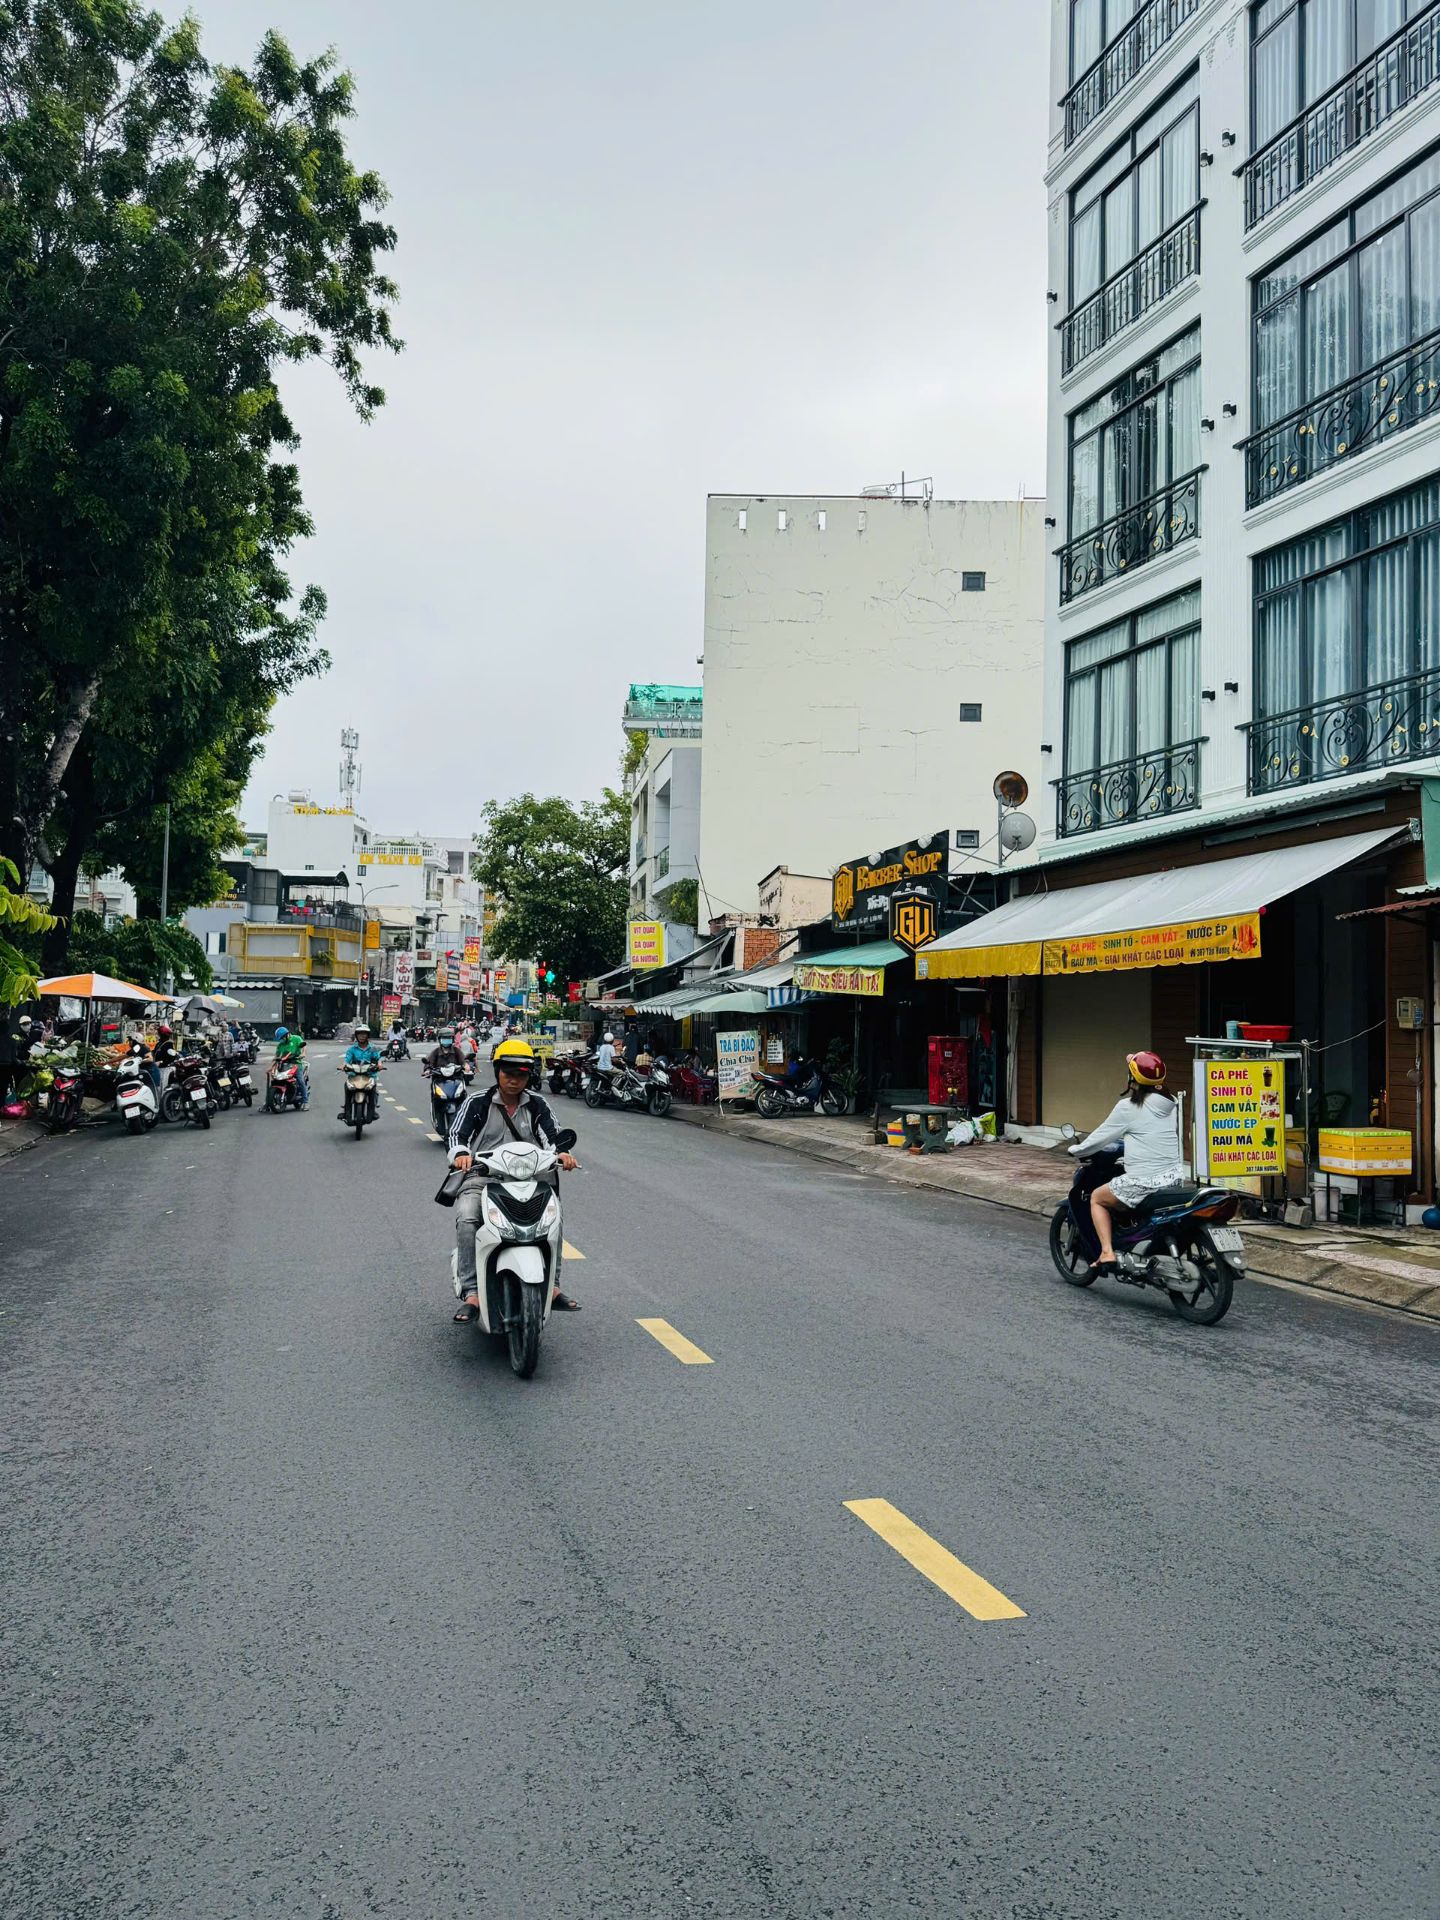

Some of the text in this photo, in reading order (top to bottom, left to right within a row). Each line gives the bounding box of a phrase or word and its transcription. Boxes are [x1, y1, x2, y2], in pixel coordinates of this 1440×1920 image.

[856, 864, 903, 891] BARBER
[904, 850, 942, 877] SHOP
[900, 906, 930, 945] GU
[1103, 938, 1121, 949] SINH
[1141, 933, 1159, 945] CAM
[1187, 925, 1212, 939] NƯỚC
[1215, 923, 1228, 936] ÉP
[1122, 950, 1142, 963] KHÁT
[1145, 948, 1161, 961] CÁC
[1164, 947, 1184, 960] LOẠI
[1211, 1068, 1249, 1080] CÀ PHÊ
[1211, 1083, 1253, 1096] SINH TỐ
[1212, 1103, 1235, 1112] CAM
[1212, 1117, 1257, 1129] NƯỚC ÉP
[1213, 1133, 1253, 1145] RAU MÁ
[1228, 1150, 1245, 1162] KHÁT
[1262, 1150, 1277, 1162] LOẠI
